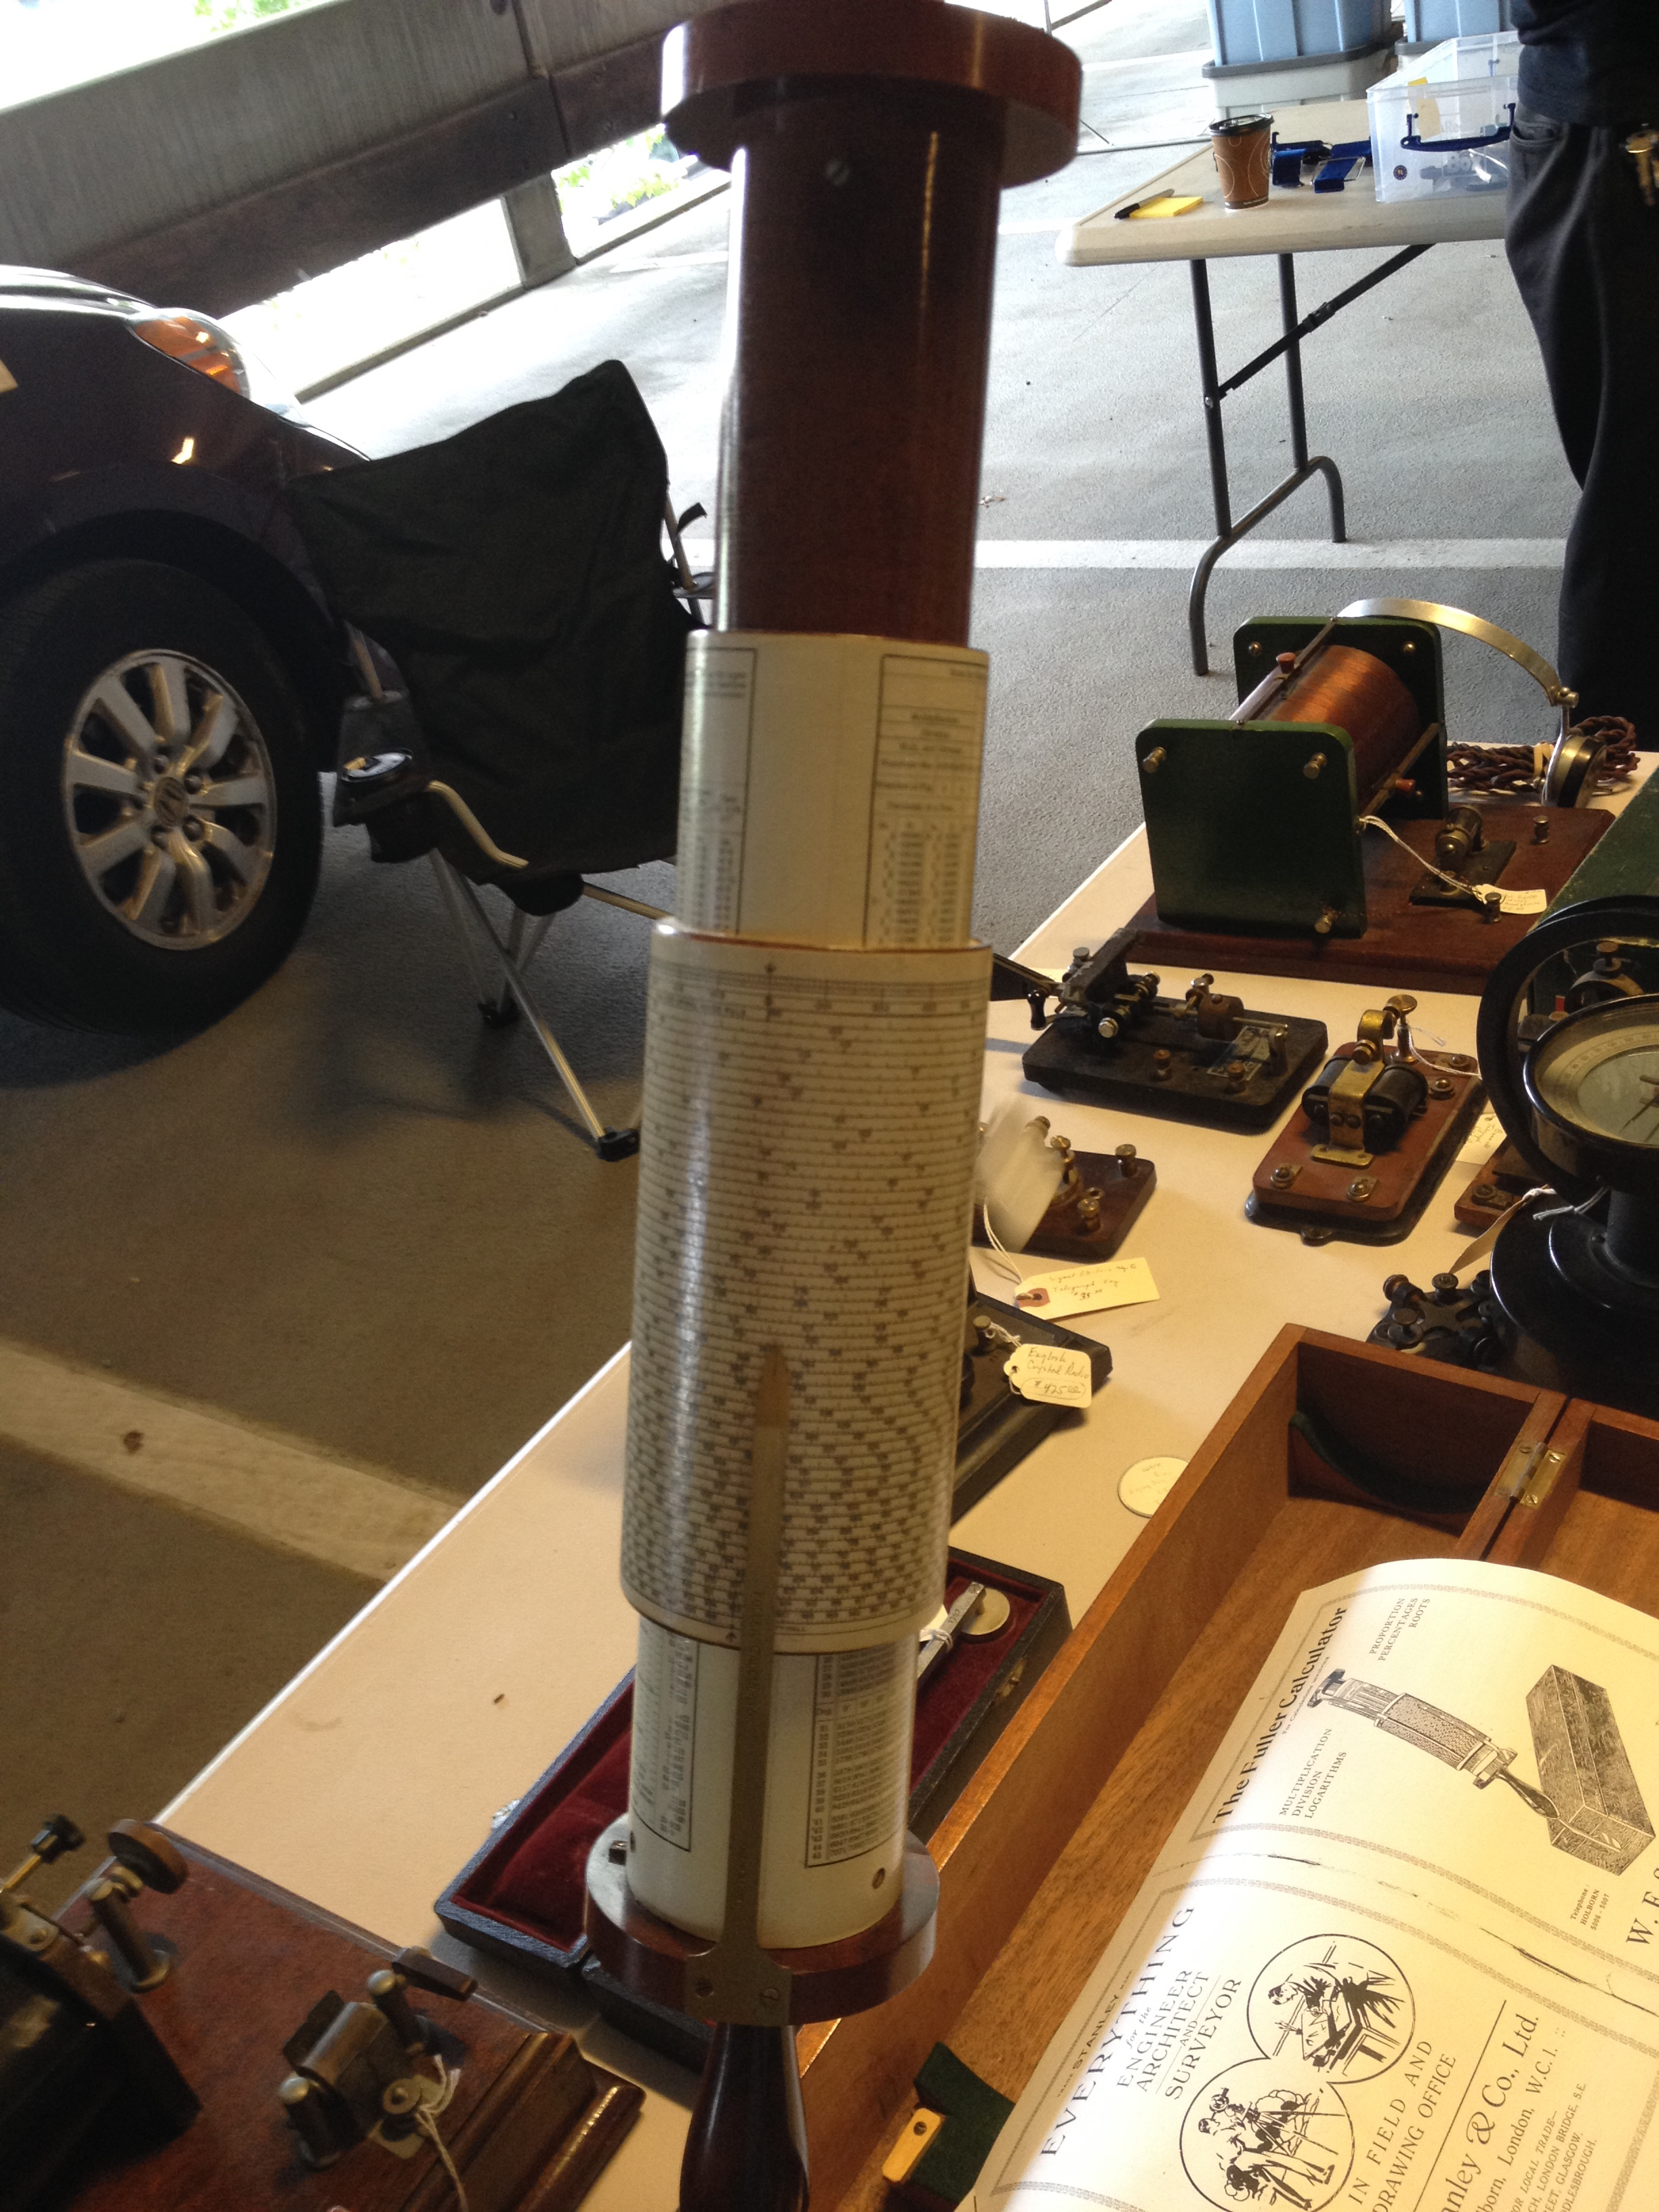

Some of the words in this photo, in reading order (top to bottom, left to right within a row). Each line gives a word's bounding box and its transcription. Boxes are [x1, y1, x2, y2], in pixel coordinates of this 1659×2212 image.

[1369, 1598, 1405, 1654] PROPORTION
[1377, 1597, 1418, 1661] PERCENTAGES
[1408, 1598, 1430, 1629] ROOTS
[1212, 1779, 1250, 1823] The
[1240, 1712, 1287, 1776] Fuller
[1279, 1607, 1347, 1708] Calculator
[1279, 1728, 1332, 1816] MULTIPLICATION
[1292, 1770, 1322, 1817] DIVISION
[1305, 1751, 1347, 1819] LOGARITHMS
[1580, 1889, 1599, 1925] HOLBORN
[1040, 1907, 1195, 2156] EVERYTHING
[1072, 1994, 1120, 2070] STANLEY
[1116, 1970, 1193, 2087] ENGINEER
[1126, 2029, 1138, 2049] for
[1139, 2007, 1152, 2024] the
[1136, 1971, 1209, 2092] ARCHITECT
[1165, 1979, 1242, 2100] SURVEYOR
[1180, 2020, 1198, 2047] AND
[1418, 2053, 1456, 2118] OFFICE
[1466, 2111, 1495, 2145] &
[1481, 2068, 1520, 2107] Co.,
[1501, 2013, 1540, 2058] Ltd.
[1348, 2177, 1370, 2205] IN
[1366, 2098, 1406, 2165] FIELD
[1404, 2041, 1432, 2087] AND
[1536, 2146, 1560, 2192] LONDON
[1556, 2104, 1579, 2143] BRIDGE,
[1573, 2083, 1586, 2100] S.E.
[1555, 2131, 1583, 2186] GLASGOW.
[1476, 2177, 1507, 2212] born,
[1496, 2108, 1535, 2167] London,
[1511, 2197, 1523, 2212] OR
[1520, 2158, 1540, 2194] LOCAL
